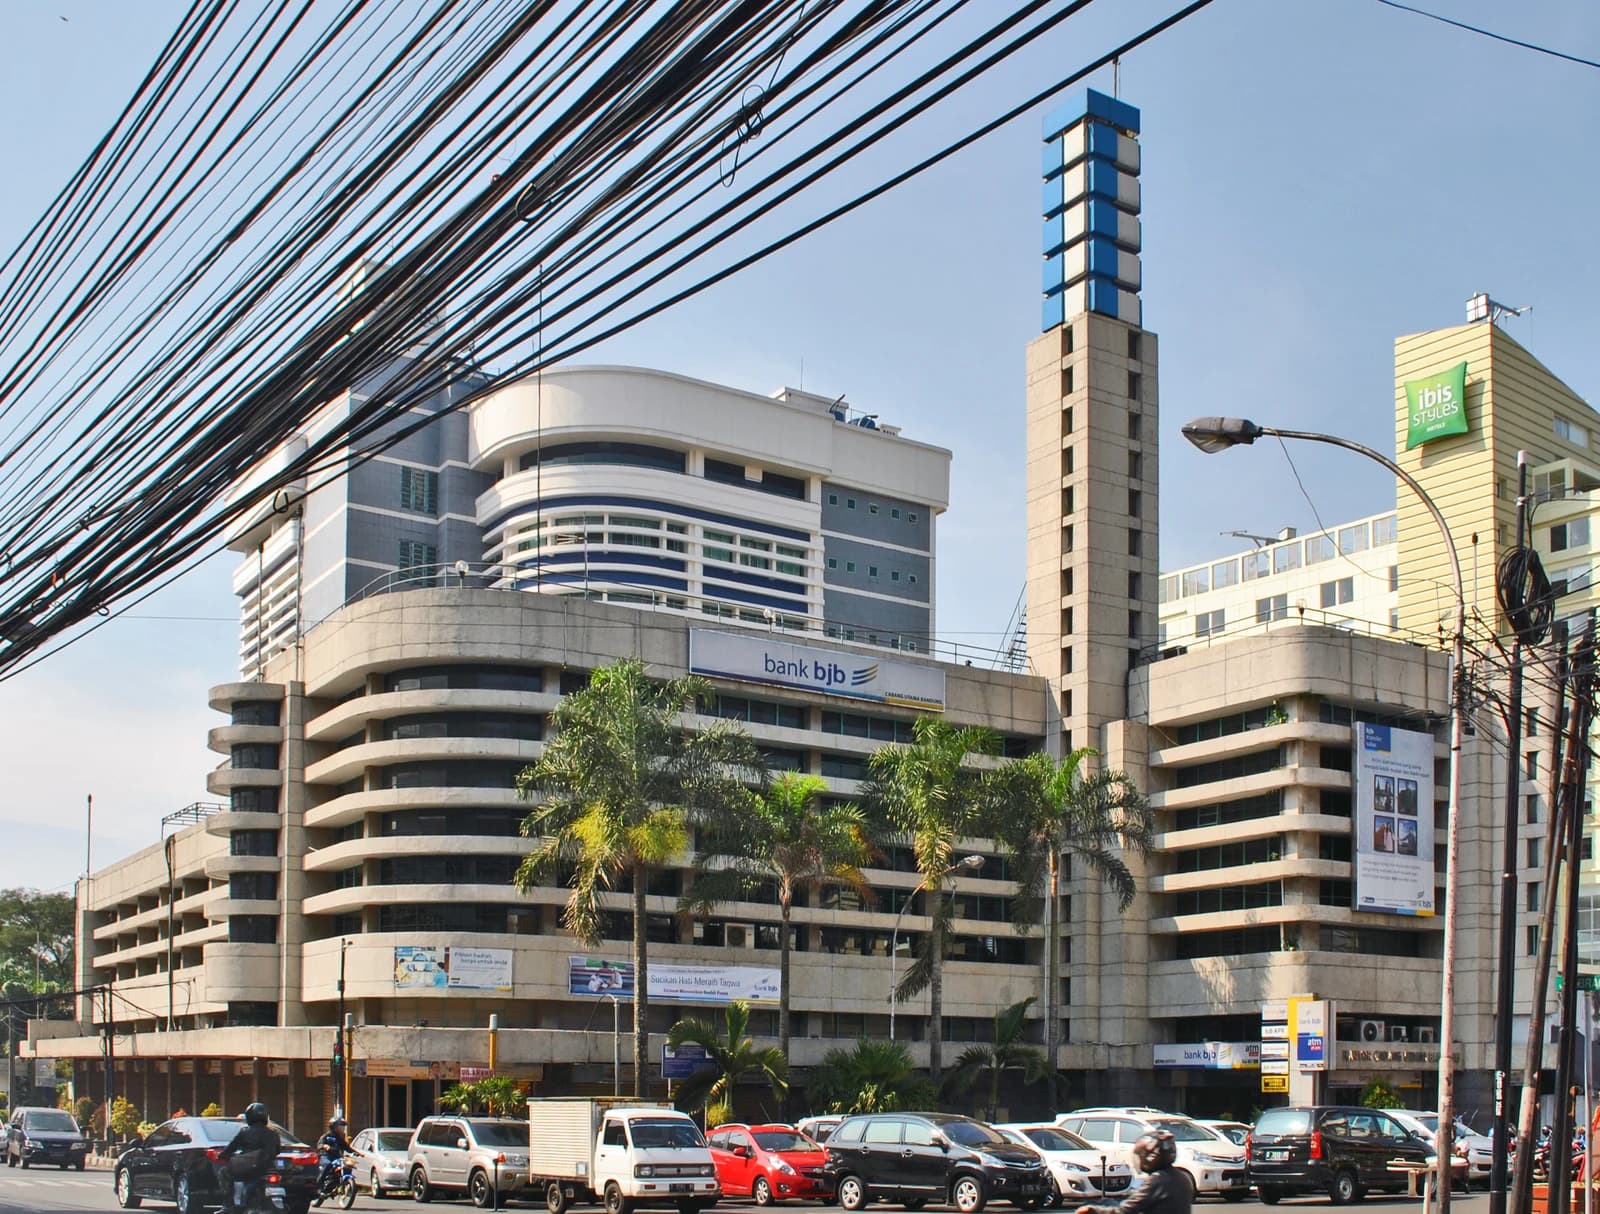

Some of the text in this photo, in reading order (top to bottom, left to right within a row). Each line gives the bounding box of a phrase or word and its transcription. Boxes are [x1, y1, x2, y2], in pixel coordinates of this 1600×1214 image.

[1418, 384, 1452, 410] ibis
[764, 652, 846, 686] bank bjb
[650, 975, 677, 984] Sucikan
[678, 976, 693, 985] Hati
[694, 977, 718, 986] Meraih
[1184, 1050, 1216, 1060] bank bjb
